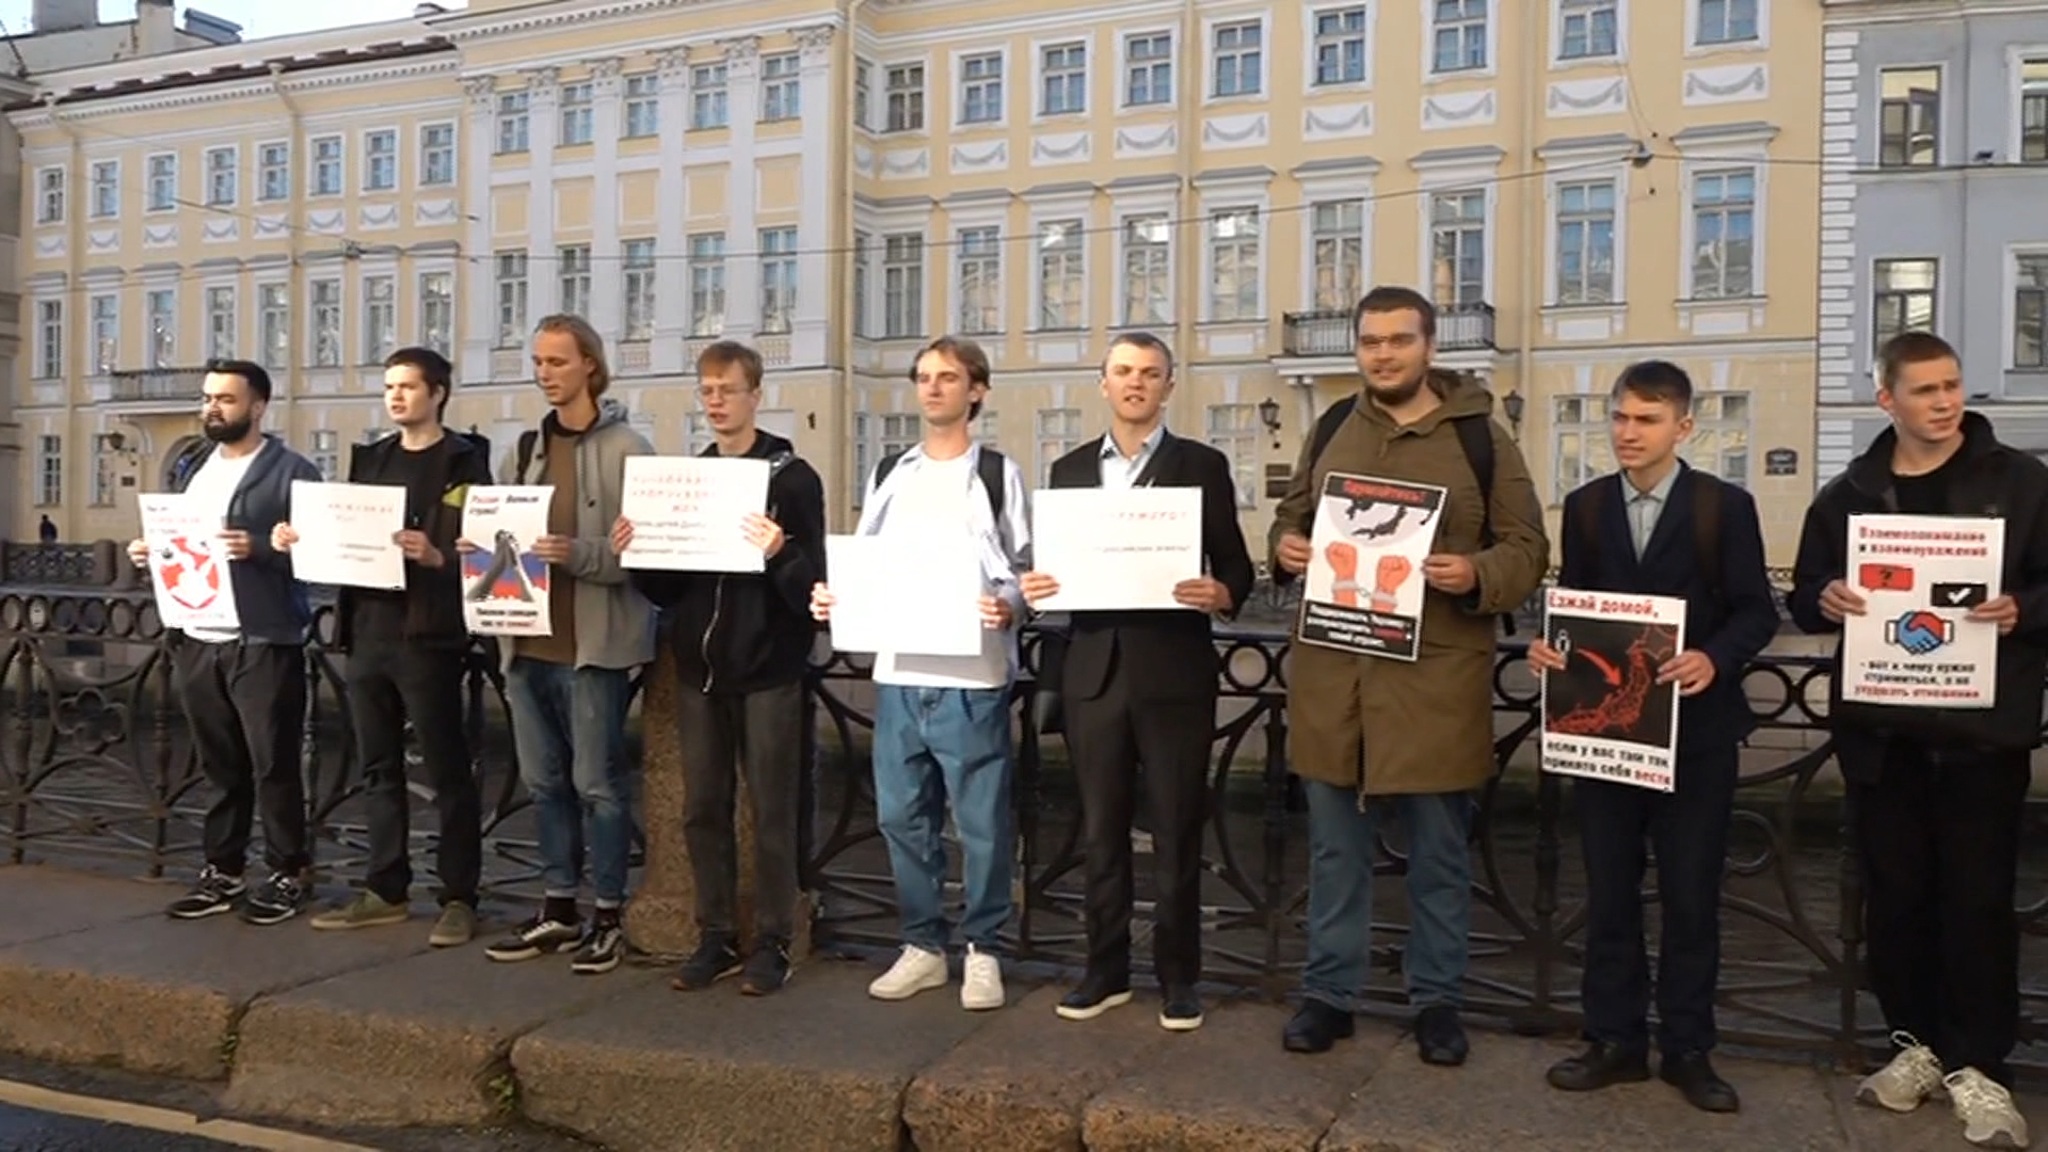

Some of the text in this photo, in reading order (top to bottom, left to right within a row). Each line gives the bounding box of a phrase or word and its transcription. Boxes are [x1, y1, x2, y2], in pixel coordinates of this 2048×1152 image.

[1549, 591, 1596, 611] Езжай
[1547, 741, 1577, 754] если
[1592, 746, 1615, 759] вас
[1619, 750, 1644, 763] там
[1648, 755, 1669, 768] так
[1544, 757, 1671, 786] принято себя вести
